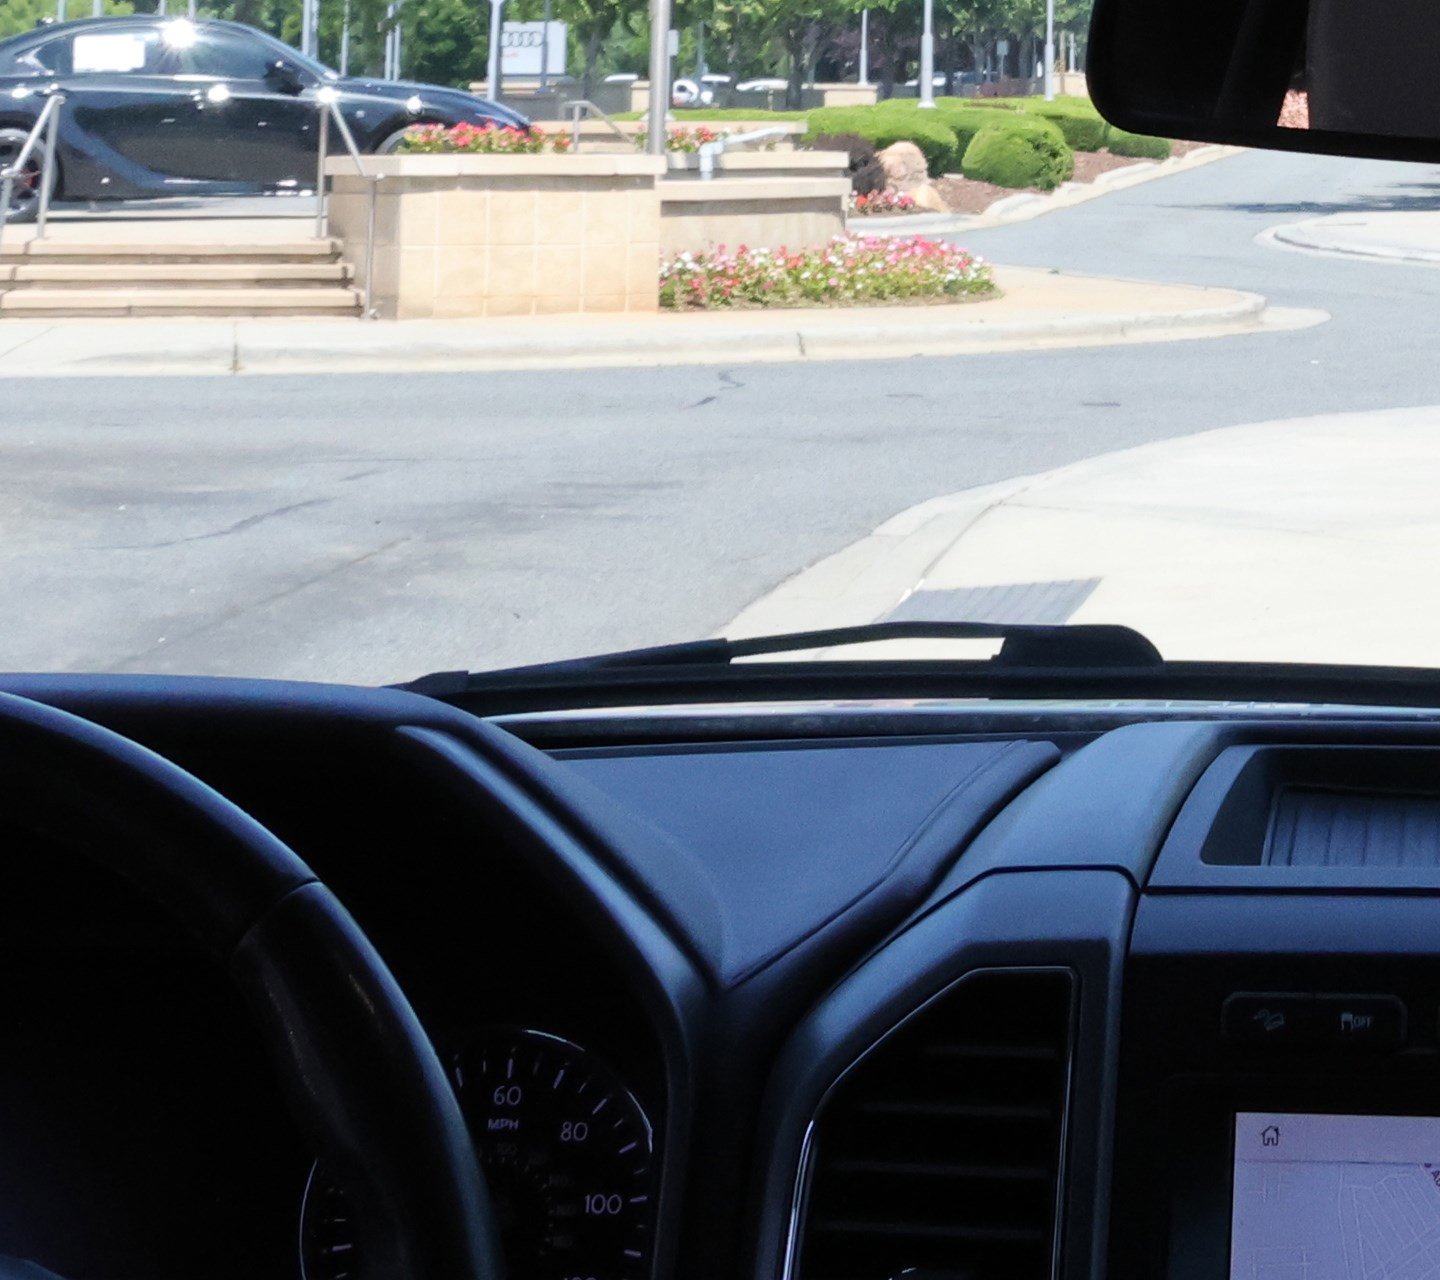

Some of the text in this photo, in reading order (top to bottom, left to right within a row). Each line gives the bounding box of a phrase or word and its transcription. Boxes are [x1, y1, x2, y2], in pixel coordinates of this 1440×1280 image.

[492, 1085, 523, 1106] 60
[487, 1117, 520, 1131] MPH
[559, 1120, 589, 1143] 80
[583, 1193, 623, 1216] 100
